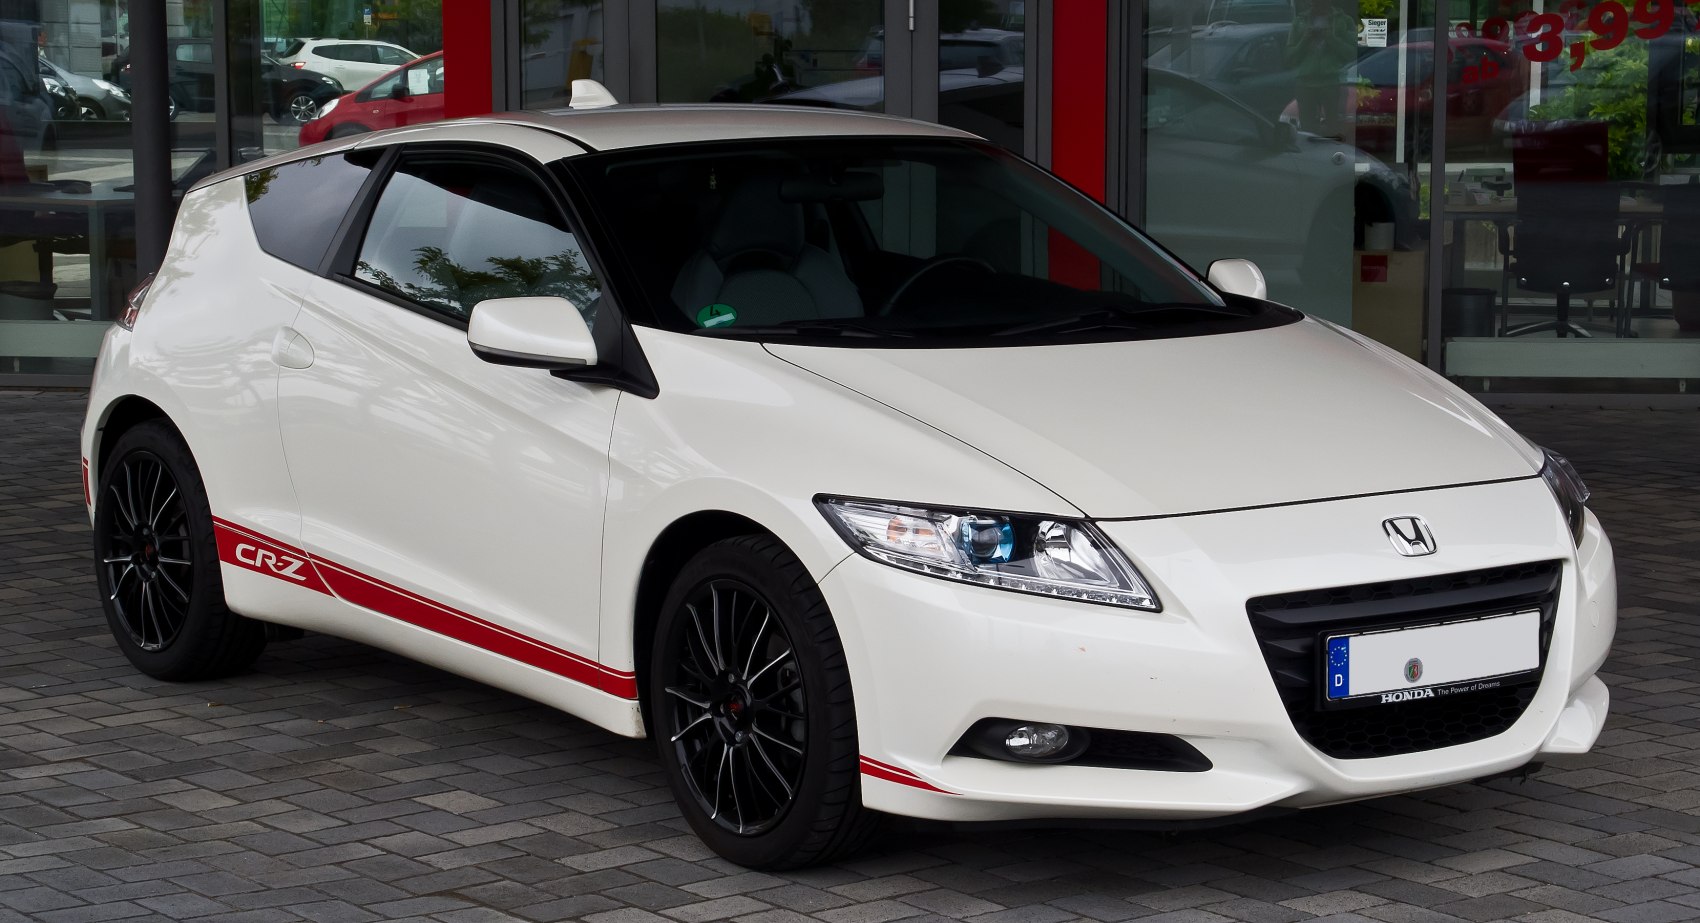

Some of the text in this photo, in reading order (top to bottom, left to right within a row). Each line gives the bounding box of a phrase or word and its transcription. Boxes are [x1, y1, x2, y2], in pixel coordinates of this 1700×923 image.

[1462, 56, 1499, 84] ab
[1523, 0, 1675, 73] 3,99
[235, 543, 307, 581] CR-Z
[1334, 674, 1343, 687] D
[1380, 681, 1501, 704] HONDA The Power of Dreams
